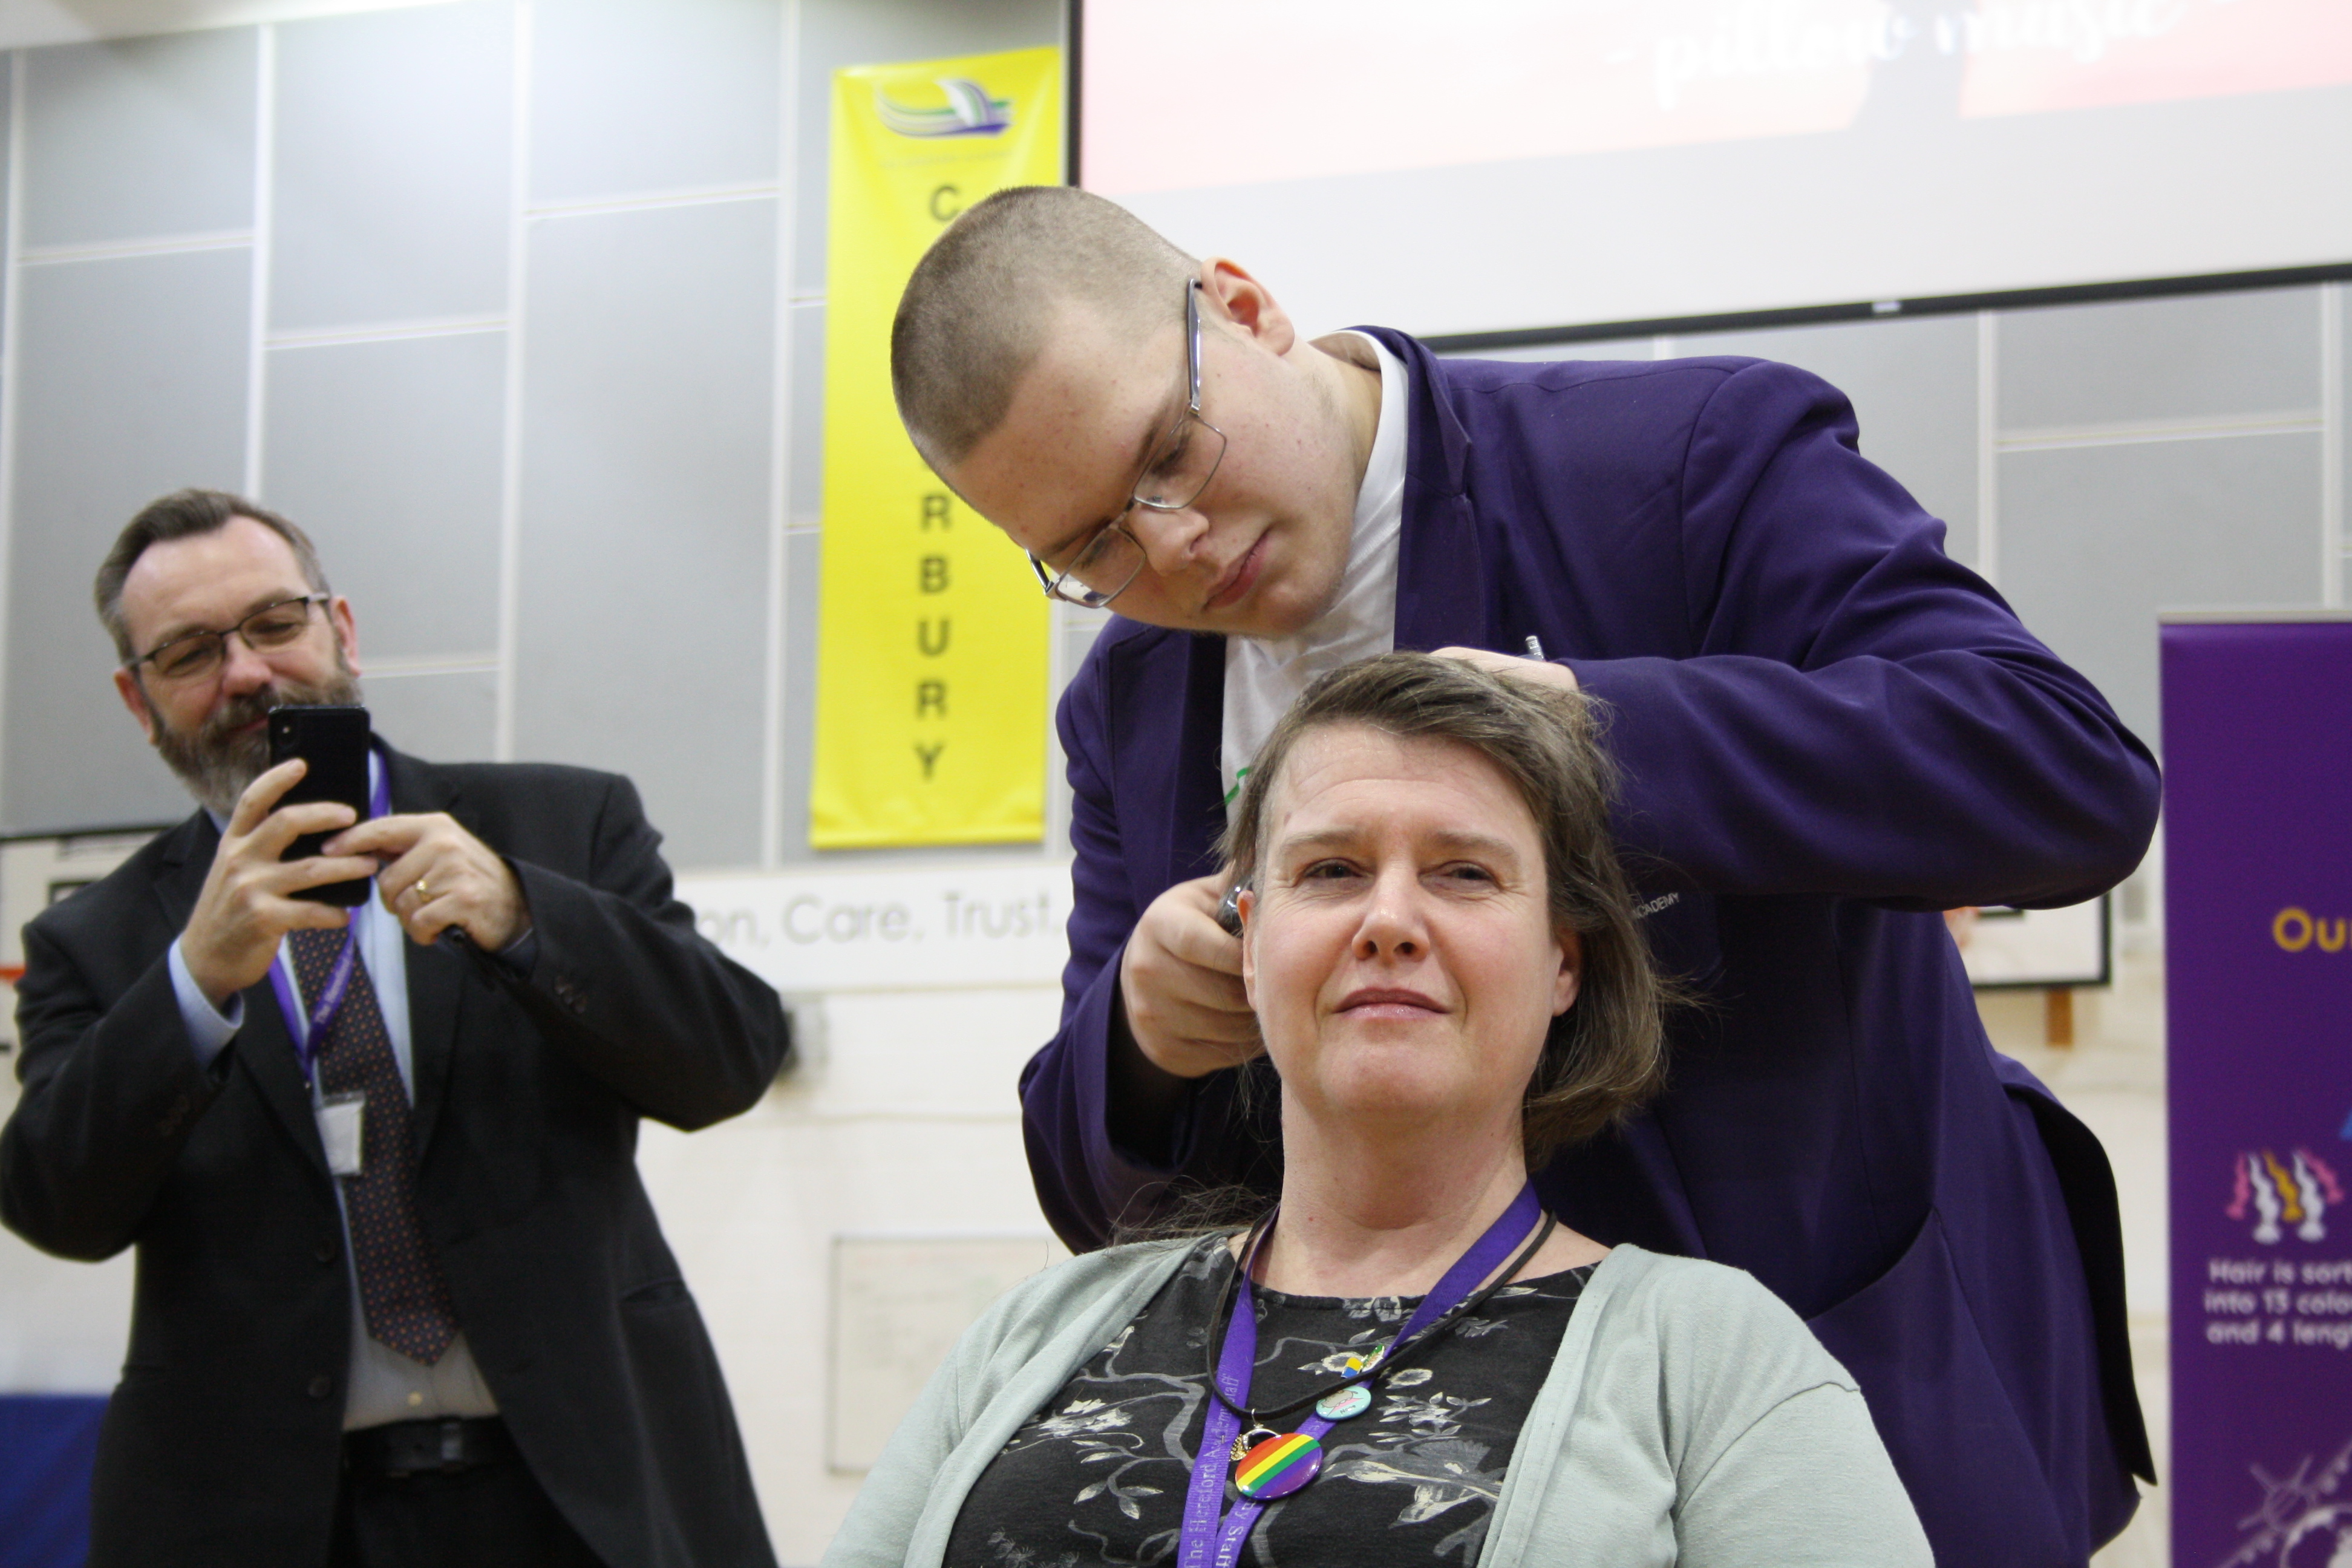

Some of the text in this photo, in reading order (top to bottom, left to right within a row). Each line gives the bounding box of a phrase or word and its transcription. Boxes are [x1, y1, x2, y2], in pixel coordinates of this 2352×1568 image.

[1651, 0, 2187, 111] pillow music
[2272, 907, 2352, 953] Ou
[2209, 1258, 2266, 1284] Hair
[2273, 1258, 2295, 1284] is
[2204, 1288, 2258, 1315] into
[2207, 1318, 2352, 1350] and 4 leng
[1221, 1373, 1240, 1403] taff
